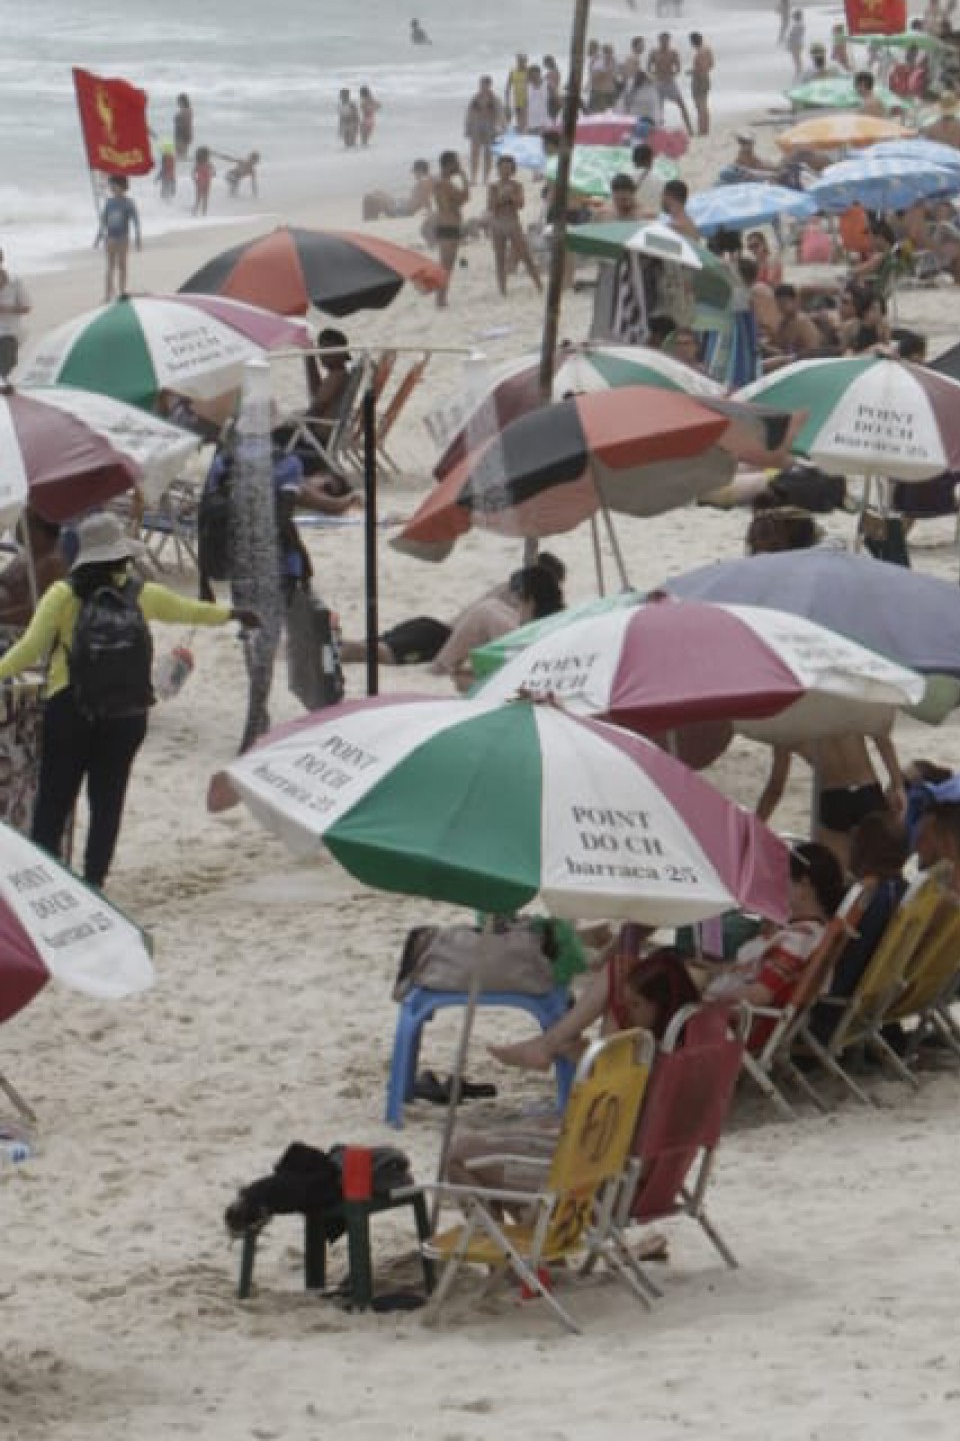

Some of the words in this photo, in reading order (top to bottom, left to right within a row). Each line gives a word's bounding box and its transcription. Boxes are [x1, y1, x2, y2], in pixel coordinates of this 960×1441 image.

[321, 734, 378, 771] POINT
[571, 806, 649, 829] POINT
[580, 832, 618, 851] DO
[565, 857, 660, 881] barraca
[664, 864, 699, 883] 25
